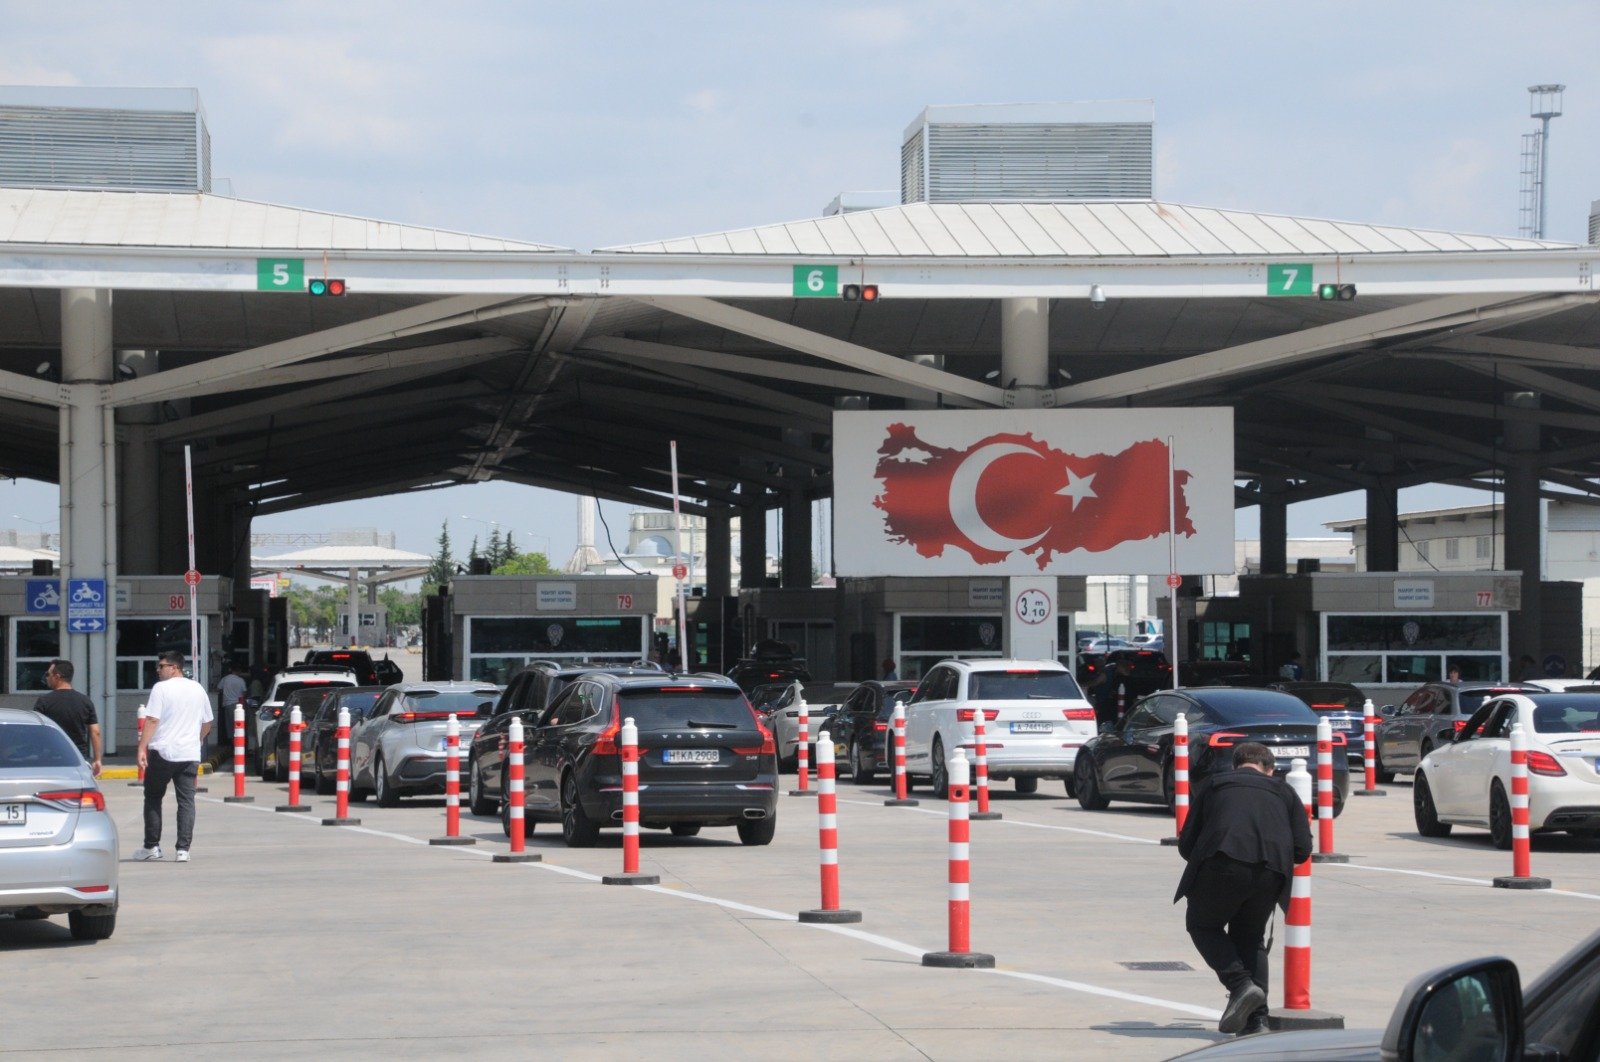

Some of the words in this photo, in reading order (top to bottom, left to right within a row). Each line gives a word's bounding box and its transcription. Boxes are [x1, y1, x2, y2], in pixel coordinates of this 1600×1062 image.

[273, 263, 290, 286] 5
[807, 270, 824, 292] 6
[1282, 269, 1299, 290] 7
[170, 596, 185, 609] 80
[618, 595, 632, 609] 79
[1021, 597, 1028, 616] 3
[1477, 592, 1491, 606] 77
[6, 805, 19, 819] 15
